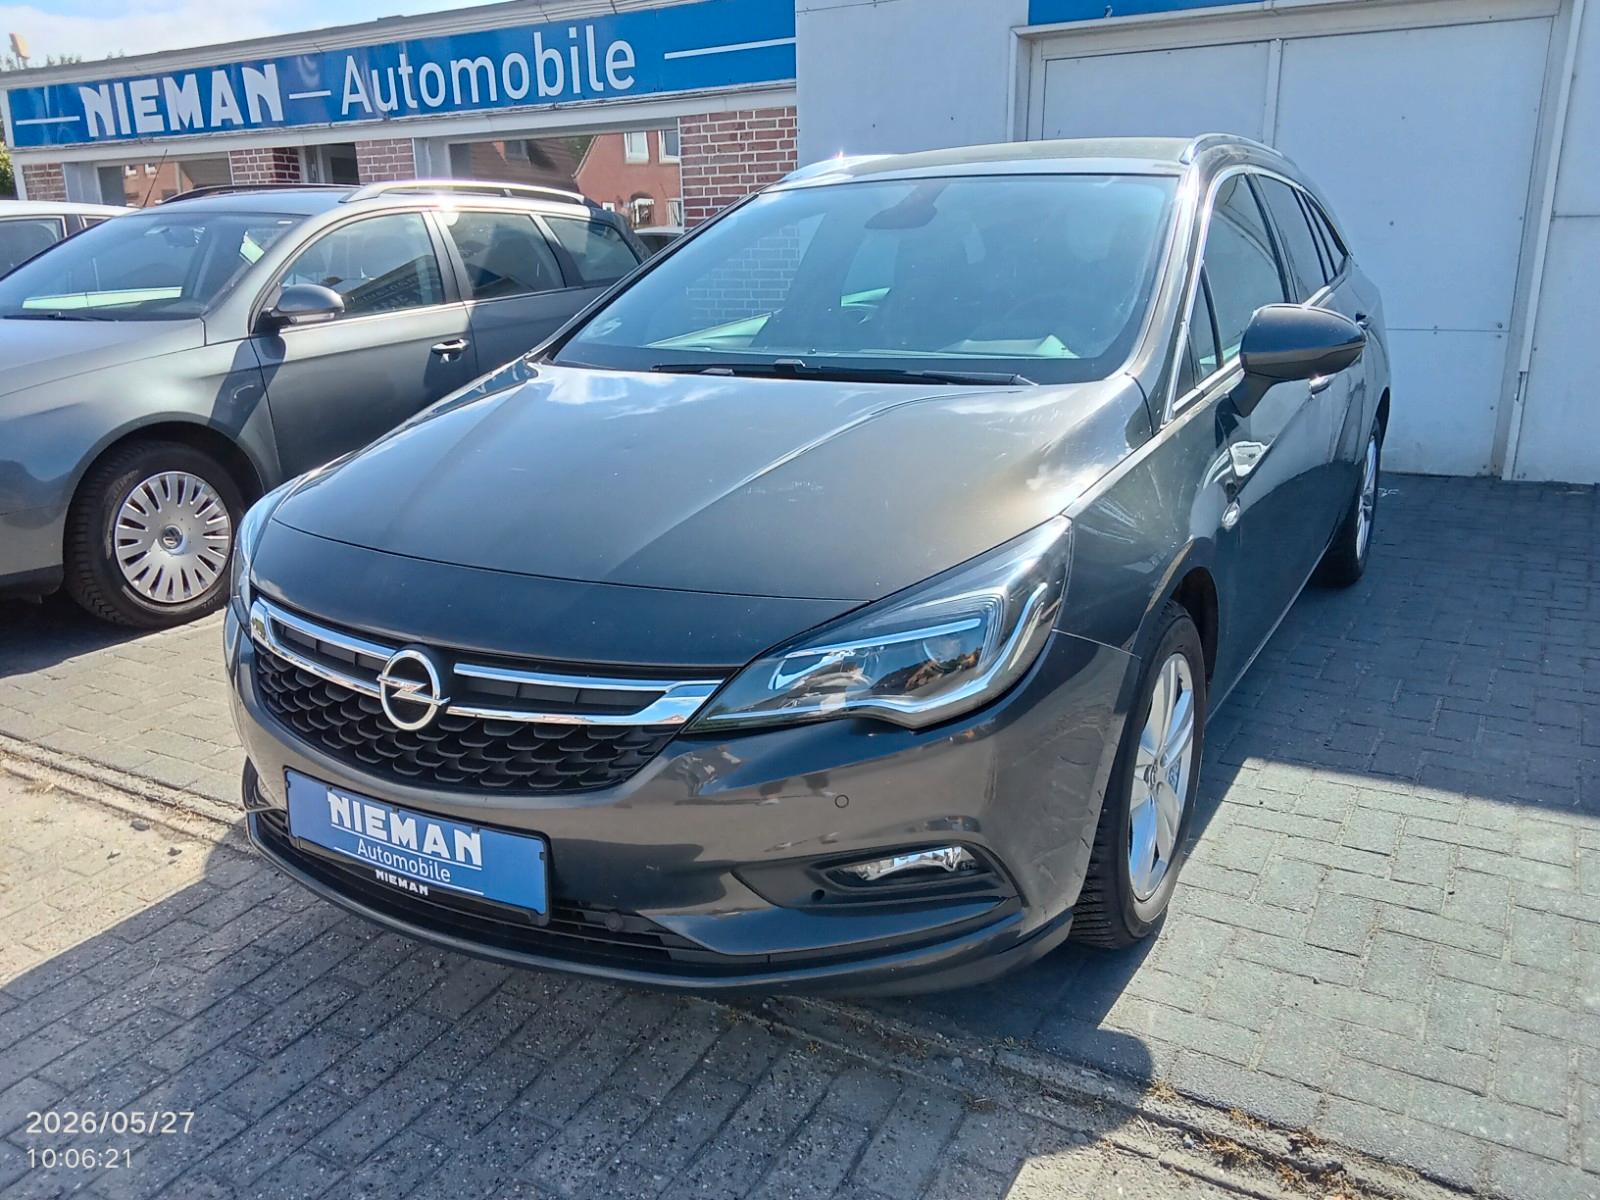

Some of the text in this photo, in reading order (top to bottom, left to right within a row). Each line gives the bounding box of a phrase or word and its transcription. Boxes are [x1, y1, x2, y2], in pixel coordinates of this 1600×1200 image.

[78, 25, 636, 138] NIEMAN Automobile
[326, 791, 482, 866] NIEMAN
[357, 838, 451, 883] Automobile
[375, 869, 429, 896] NIEMAN
